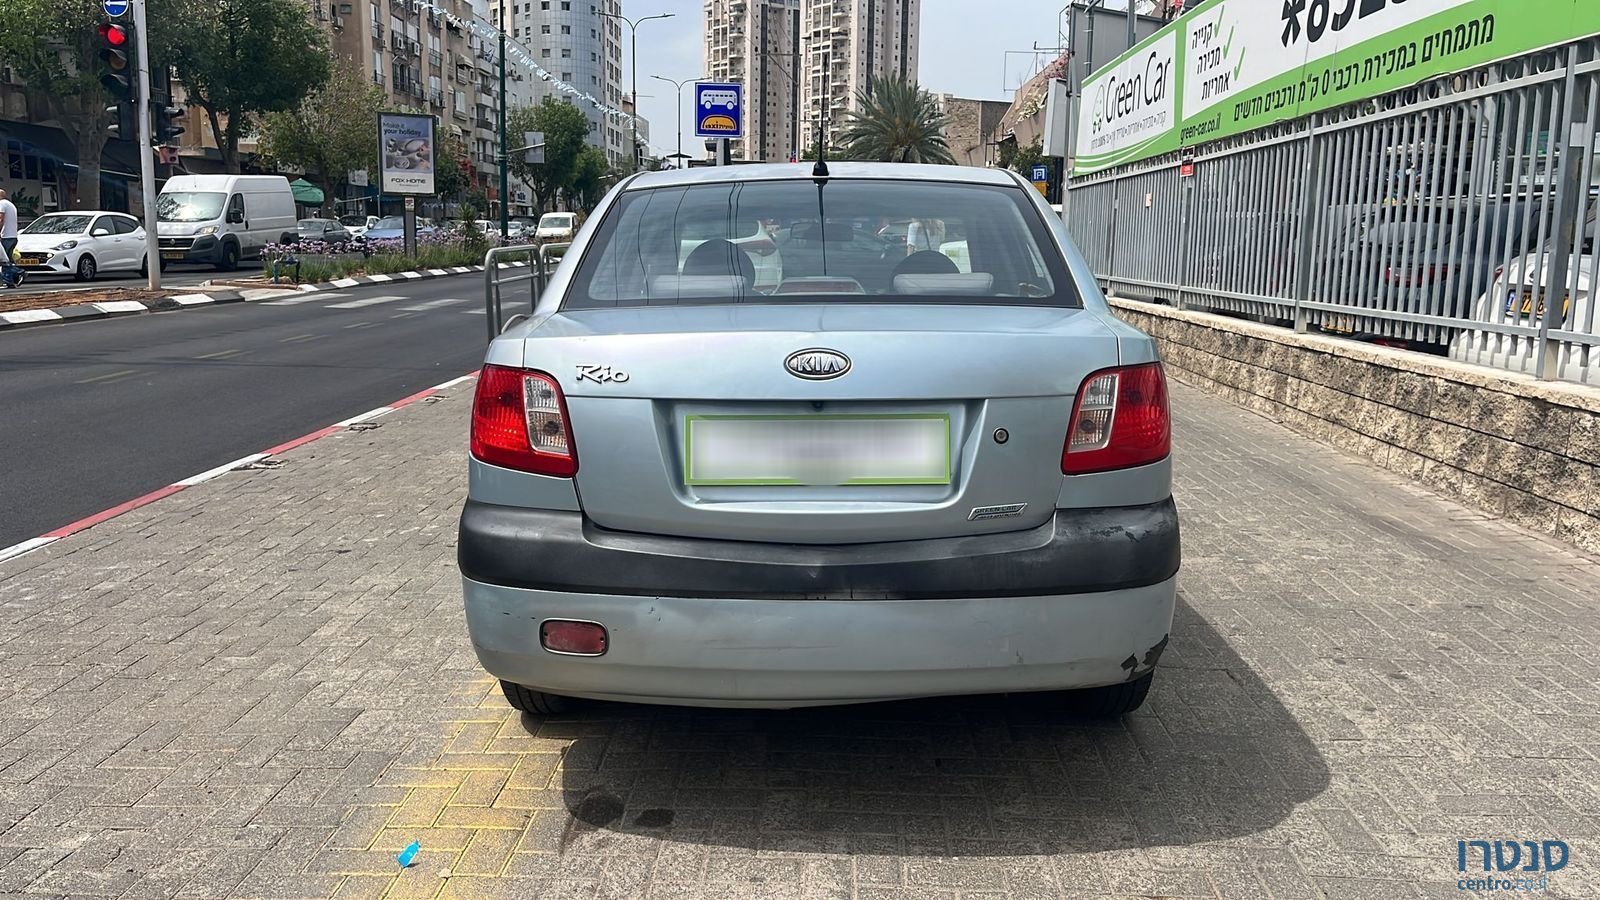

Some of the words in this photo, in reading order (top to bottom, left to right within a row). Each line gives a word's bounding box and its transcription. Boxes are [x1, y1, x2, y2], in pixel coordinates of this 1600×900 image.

[1192, 22, 1213, 49] קנייה
[1421, 14, 1495, 63] מתמחים
[1196, 46, 1221, 75] מכירה
[1361, 42, 1417, 83] במכירת
[1105, 73, 1141, 123] Green
[1144, 51, 1171, 106] Car
[1201, 70, 1231, 101] אחריות
[1322, 68, 1331, 96] 0
[1333, 63, 1360, 92] רכבי
[1233, 95, 1263, 121] חדשים
[1264, 84, 1296, 112] ורכבים
[383, 128, 398, 136] your
[1180, 112, 1221, 144] green-car.co.il
[575, 363, 630, 384] Rio
[796, 355, 842, 373] KIA
